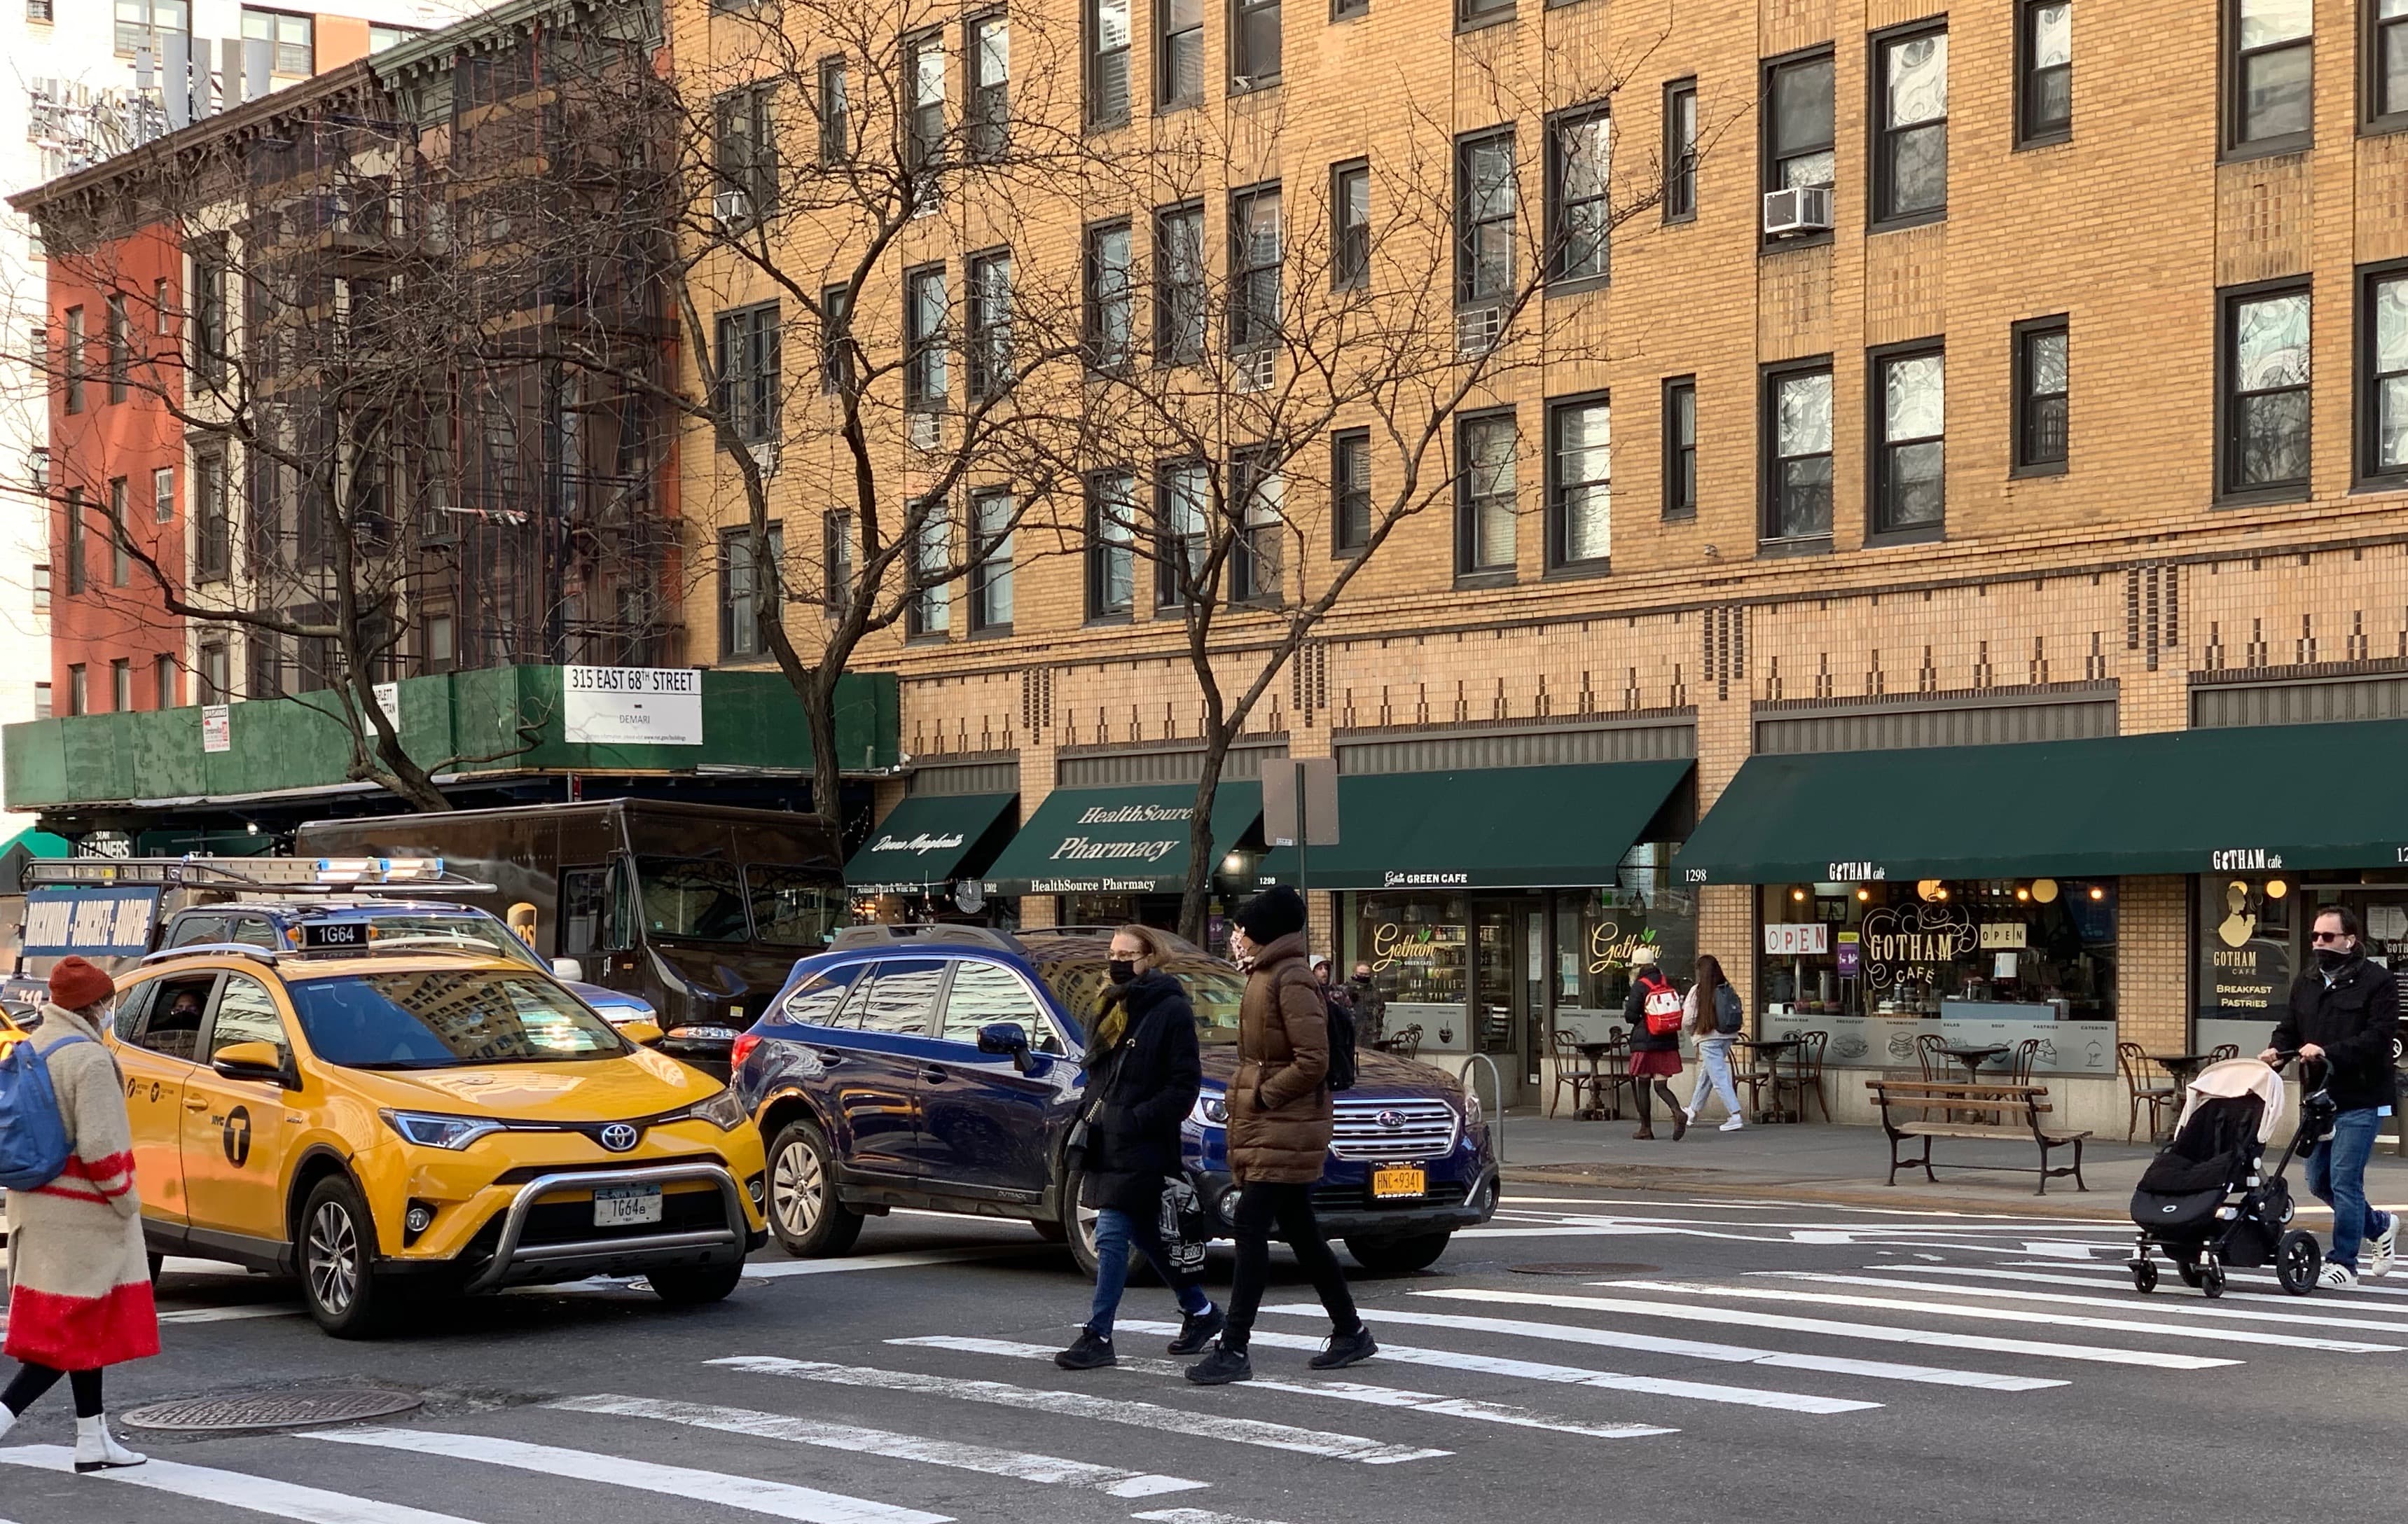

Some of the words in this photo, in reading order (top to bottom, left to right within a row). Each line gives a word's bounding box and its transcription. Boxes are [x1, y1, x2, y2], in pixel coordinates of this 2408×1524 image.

[573, 669, 593, 688] 315
[597, 670, 624, 688] EAST
[628, 670, 650, 690] 68TH
[653, 672, 693, 691] STREET
[619, 714, 650, 723] DEMARI
[1077, 804, 1193, 824] HealthSourc
[78, 840, 129, 859] CLEANERS
[1049, 836, 1180, 862] Pharmacy
[2268, 854, 2282, 868] café
[1259, 877, 1276, 885] 1298
[1406, 874, 1439, 884] GREEN
[1441, 873, 1467, 883] CAFE
[1685, 869, 1707, 882] 1298
[1873, 868, 1885, 880] café
[1031, 880, 1099, 892] HealthSource
[1102, 878, 1156, 892] Pharmacy
[319, 926, 354, 943] 1G64
[1769, 926, 1825, 952] OPEN
[1983, 931, 2023, 941] OPEN
[1372, 923, 1436, 971] Gotham
[1871, 934, 1952, 961] GOTHAM
[2213, 951, 2256, 967] GOTHAM
[1896, 966, 1935, 985] CAFÉ
[1377, 1172, 1393, 1189] HNC
[1399, 1171, 1420, 1189] 9341
